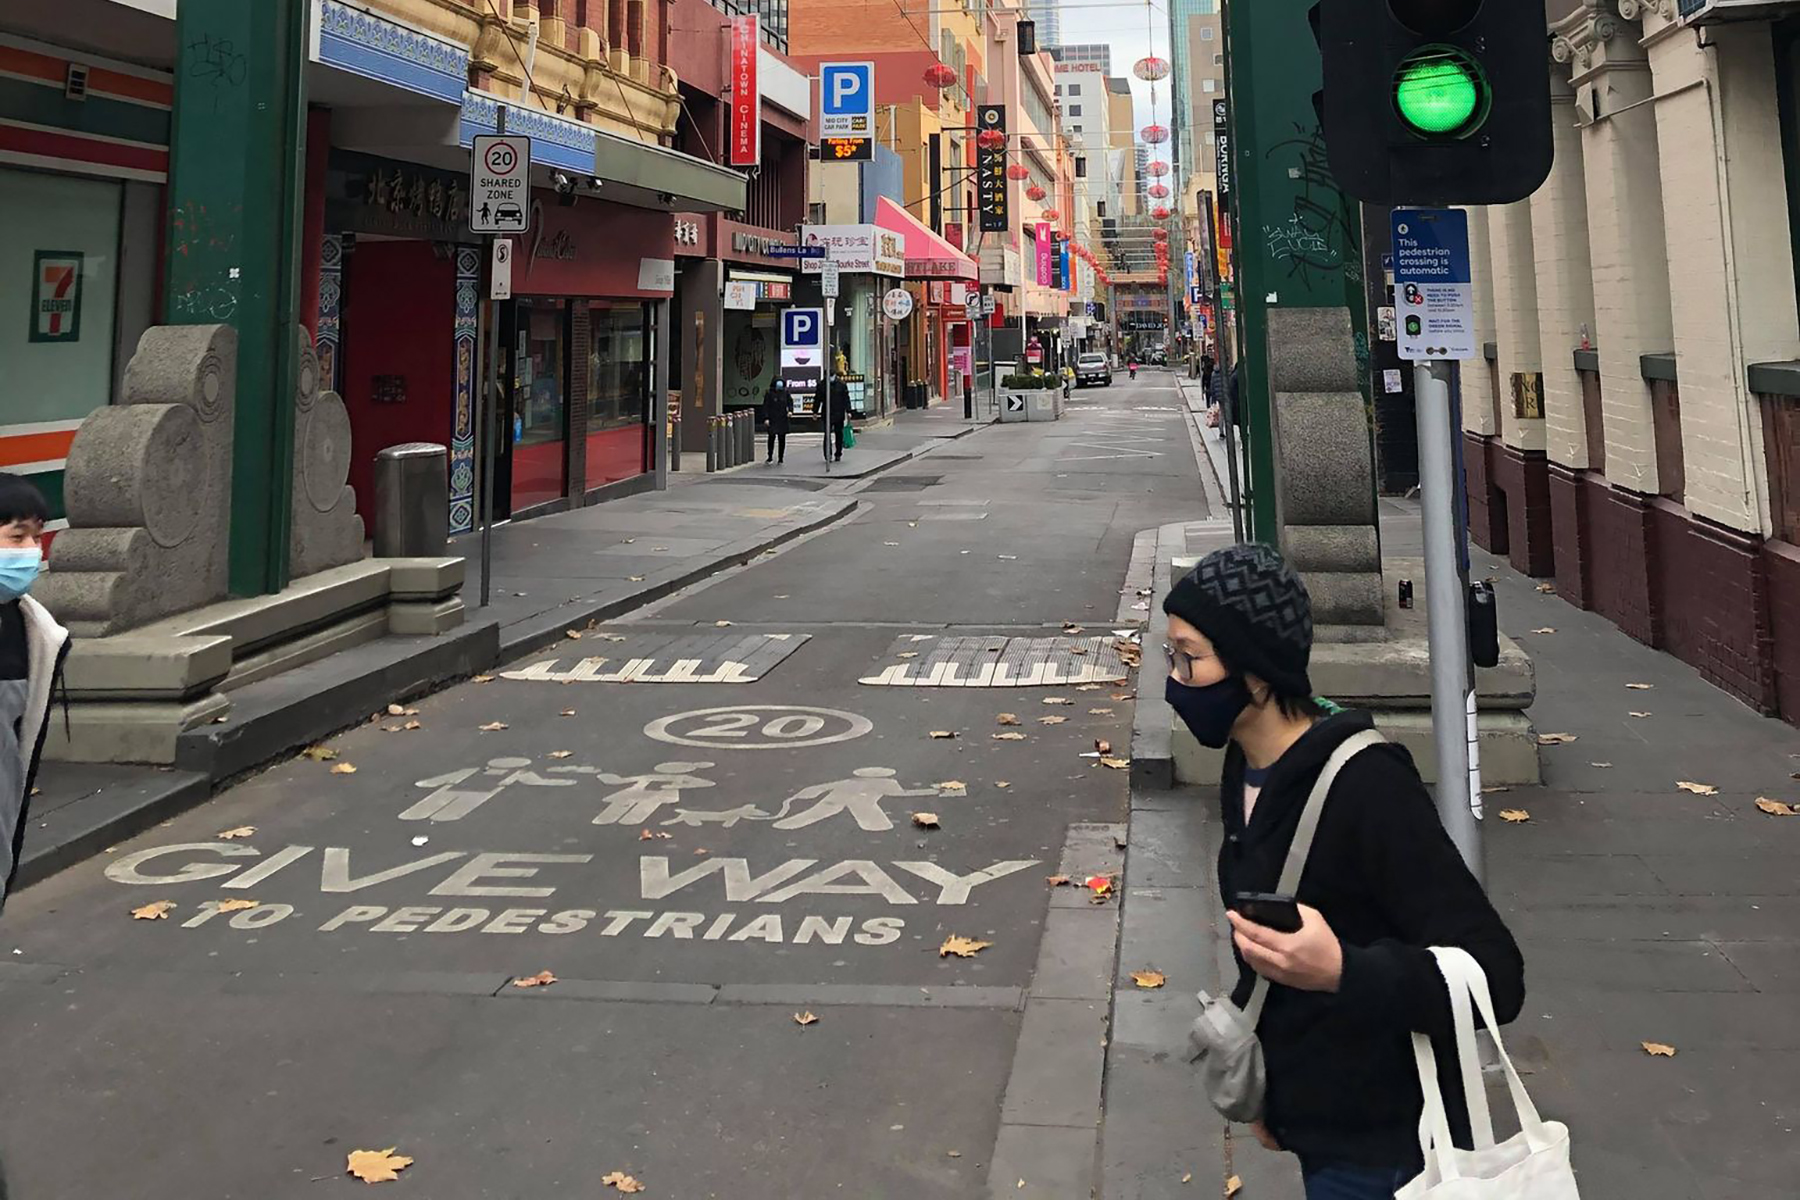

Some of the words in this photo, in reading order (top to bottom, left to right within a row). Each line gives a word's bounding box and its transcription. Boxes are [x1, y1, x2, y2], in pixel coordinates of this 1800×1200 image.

[739, 26, 749, 96] CHINATOWN
[1055, 63, 1069, 72] ME
[1071, 63, 1101, 72] HOTEL
[833, 72, 861, 108] P
[739, 104, 749, 153] CINEMA
[491, 151, 513, 166] 20
[480, 178, 521, 188] SHARED
[982, 155, 994, 215] NASTY
[486, 190, 514, 200] ZONE
[1398, 238, 1418, 247] This
[769, 246, 796, 254] Bullens
[798, 246, 807, 254] La
[1399, 248, 1451, 257] pedestrian
[803, 260, 818, 271] Shop
[854, 259, 870, 268] Street
[1040, 252, 1048, 284] clothing
[1399, 257, 1438, 267] crossing
[1440, 257, 1449, 266] is
[1400, 266, 1450, 275] automatic
[793, 314, 812, 342] P
[786, 379, 806, 388] From
[807, 379, 817, 388] $5
[684, 712, 828, 739] 20
[103, 841, 593, 897] GIVE
[639, 854, 1043, 906] WAY
[181, 901, 294, 930] TO
[317, 904, 906, 946] PEDESTRIANS
